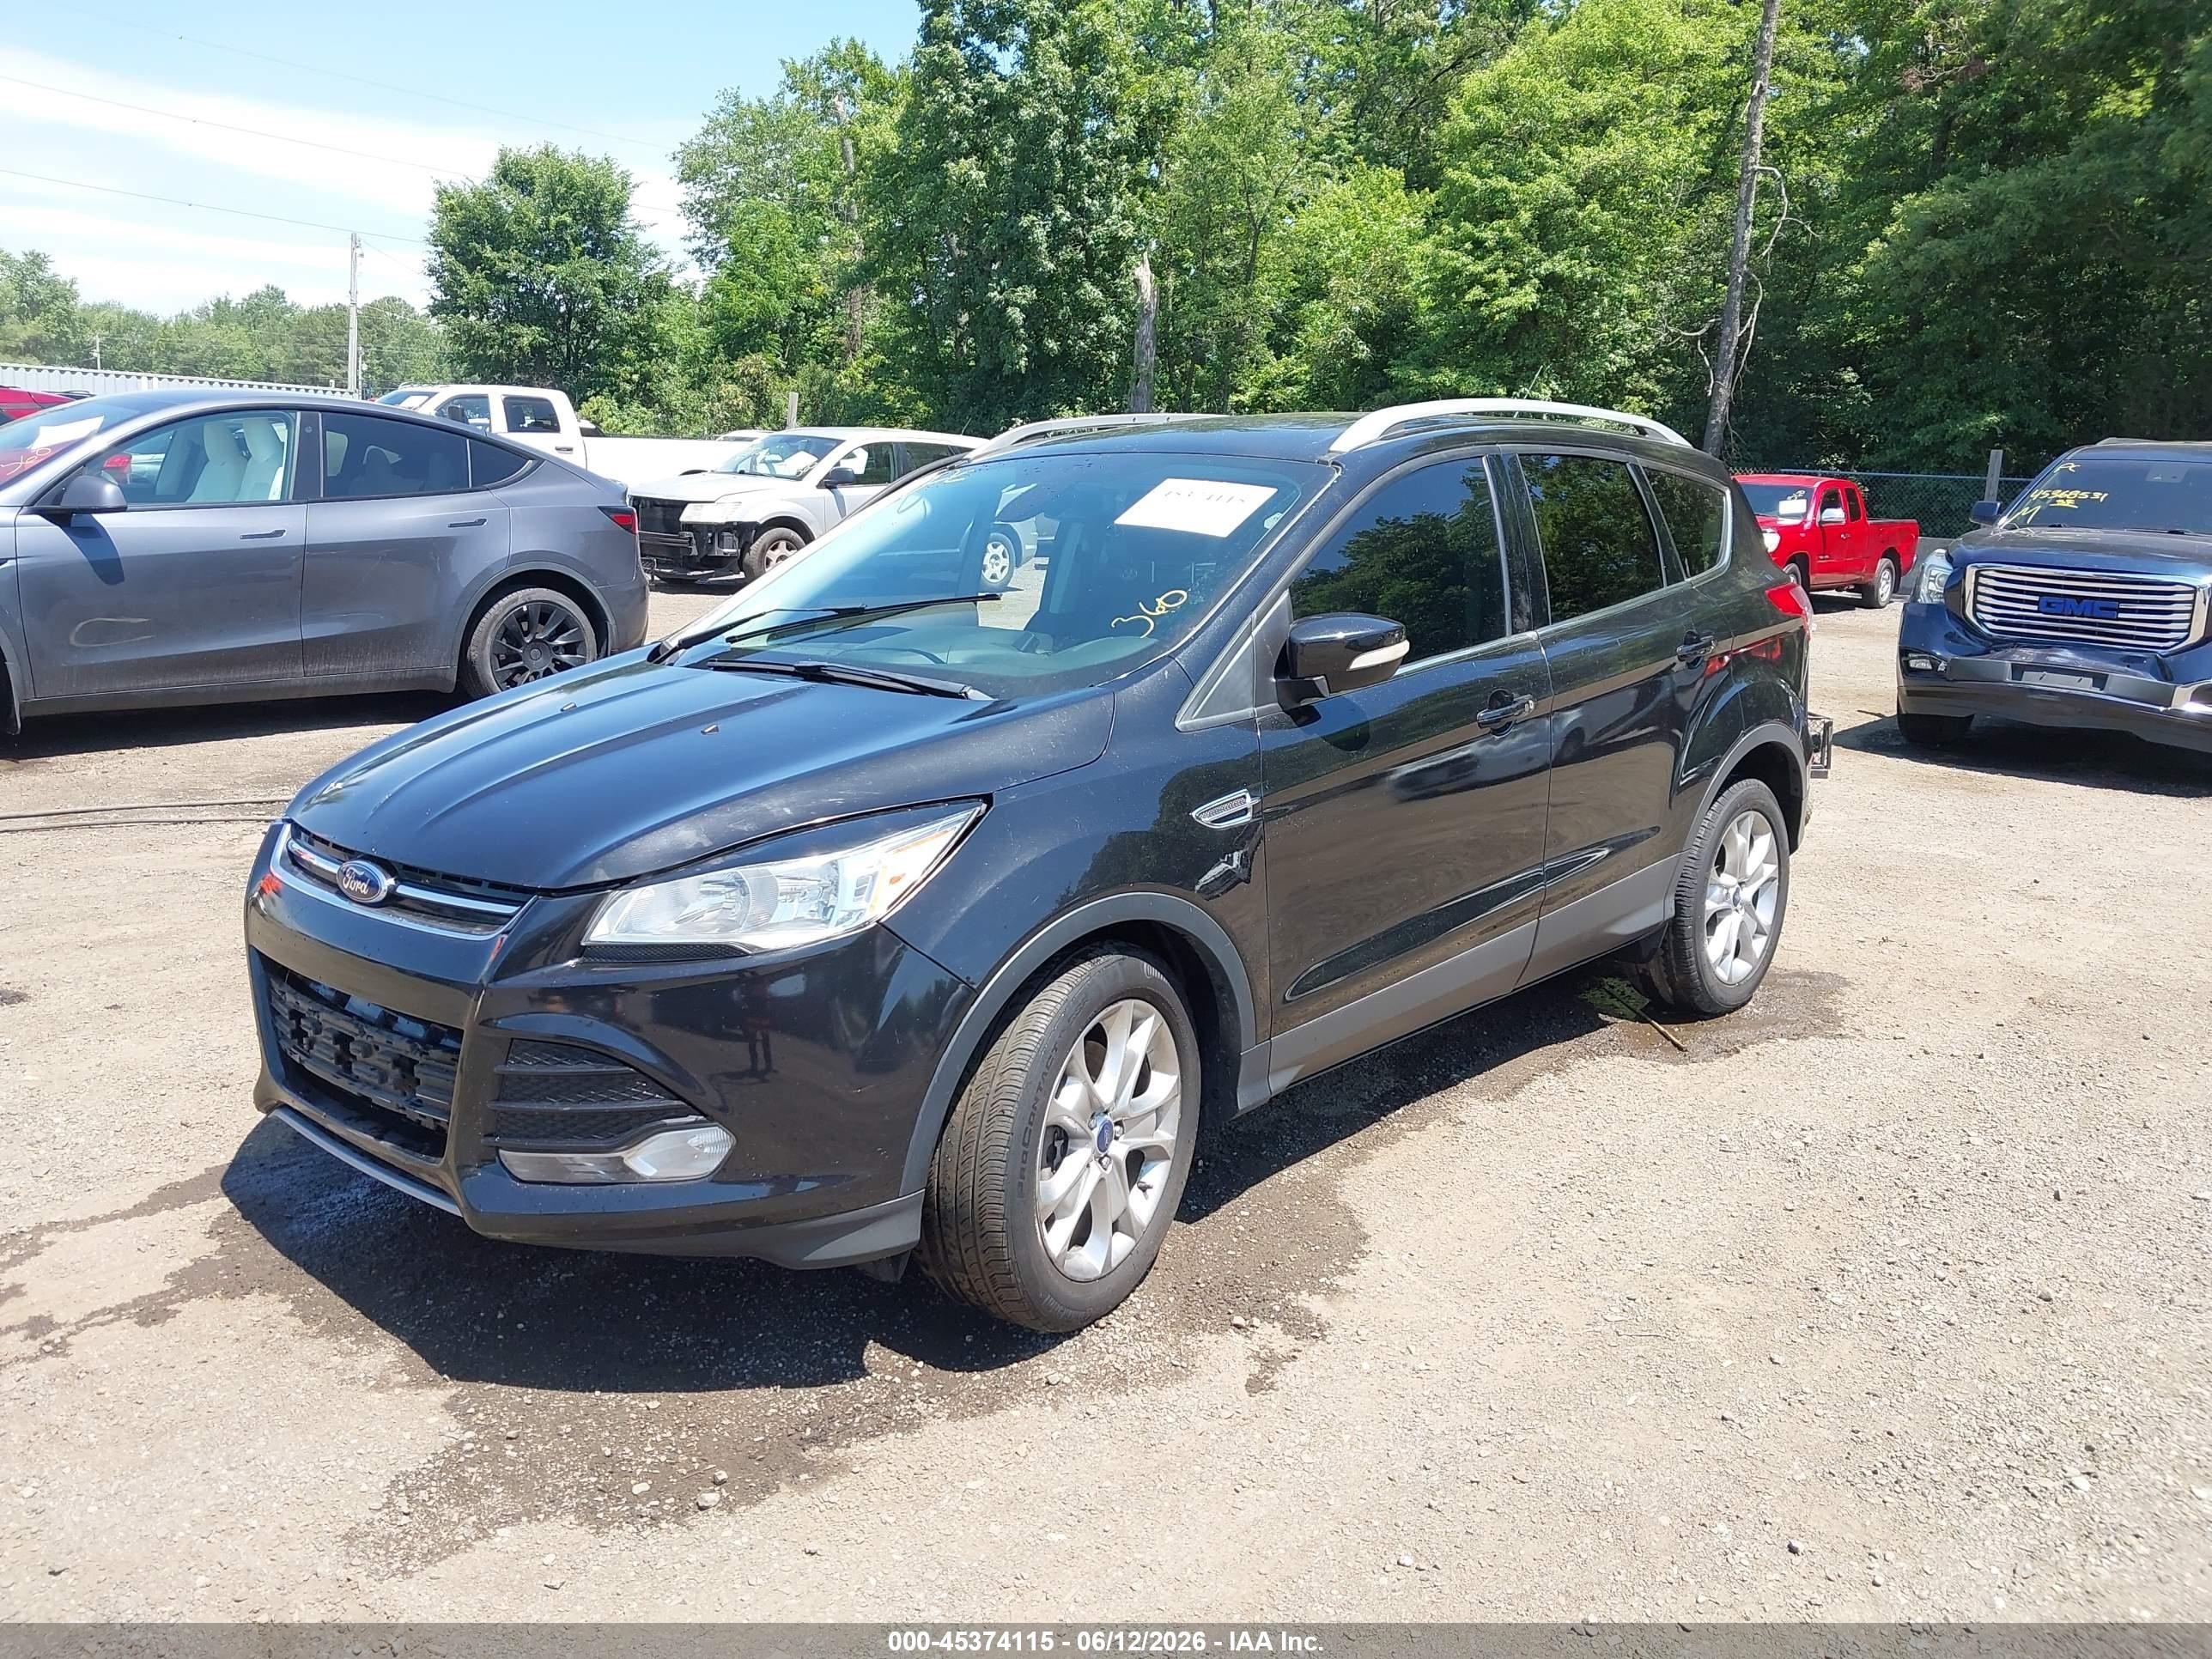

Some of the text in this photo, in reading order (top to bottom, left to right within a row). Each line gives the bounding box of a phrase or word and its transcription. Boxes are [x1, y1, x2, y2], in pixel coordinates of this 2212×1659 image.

[1111, 589, 1188, 639] 360
[2039, 596, 2118, 618] GMC
[343, 866, 371, 895] Ford
